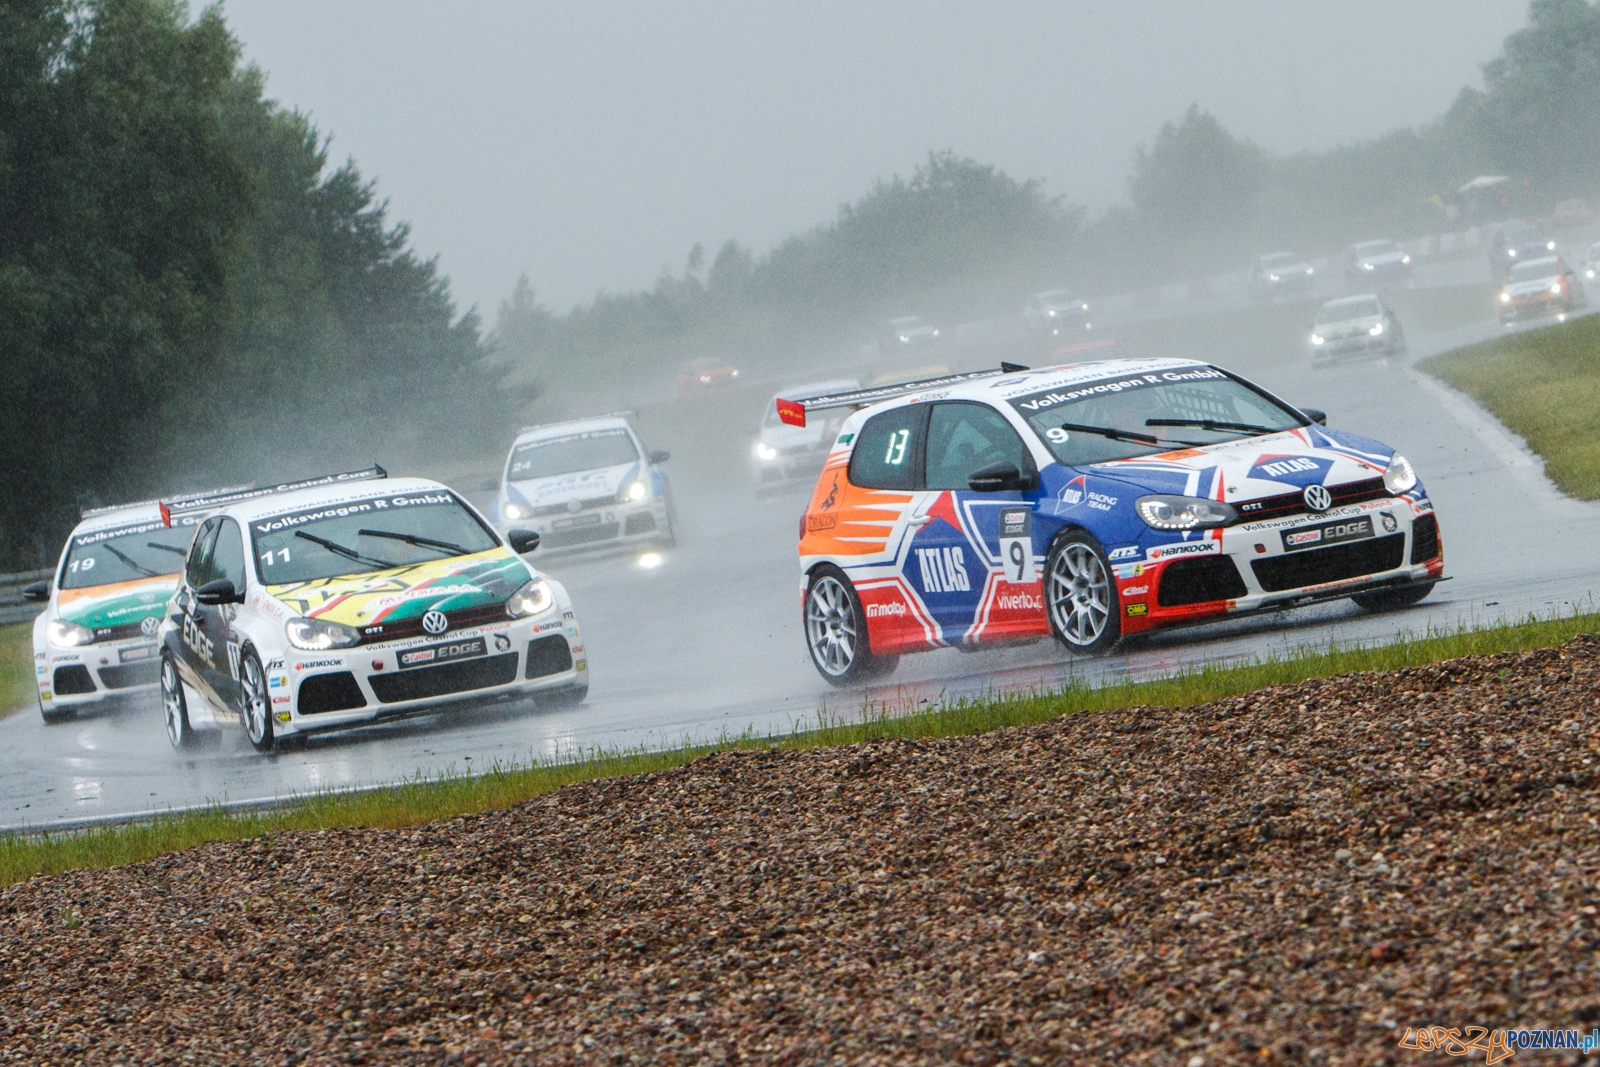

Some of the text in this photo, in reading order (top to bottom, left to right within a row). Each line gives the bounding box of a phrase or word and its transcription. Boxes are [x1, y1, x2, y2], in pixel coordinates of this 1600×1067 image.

[1019, 379, 1144, 411] Volkswagen
[1146, 375, 1164, 385] R
[1162, 369, 1227, 382] GmbH
[1046, 427, 1069, 444] 9
[885, 429, 909, 464] 13
[511, 460, 532, 473] 24
[1259, 457, 1319, 477] ATLAS
[173, 471, 370, 509] Volkswagen Castrol Cup
[1087, 491, 1119, 506] RACING
[251, 498, 345, 519] VOLKSWAGEN
[257, 494, 454, 532] Volkswagen R GmbH
[1086, 500, 1112, 511] TEAM
[1242, 502, 1263, 512] GTI
[1243, 500, 1393, 532] Volkswagen Castrol Cup Poland
[77, 522, 165, 546] Volkswagen
[1294, 531, 1320, 543] Castrol
[1324, 521, 1369, 539] EDGE
[260, 547, 291, 567] 11
[1010, 541, 1025, 581] 9
[1109, 546, 1139, 558] ATS
[69, 557, 95, 574] 19
[915, 546, 971, 593] ATLAS
[107, 602, 163, 618] Volkswagen
[1127, 604, 1147, 615] OMP
[365, 626, 383, 634] GTI
[366, 623, 512, 651] Volkswagen Castrol Cup Poland
[409, 642, 482, 661] Castrol EDGE
